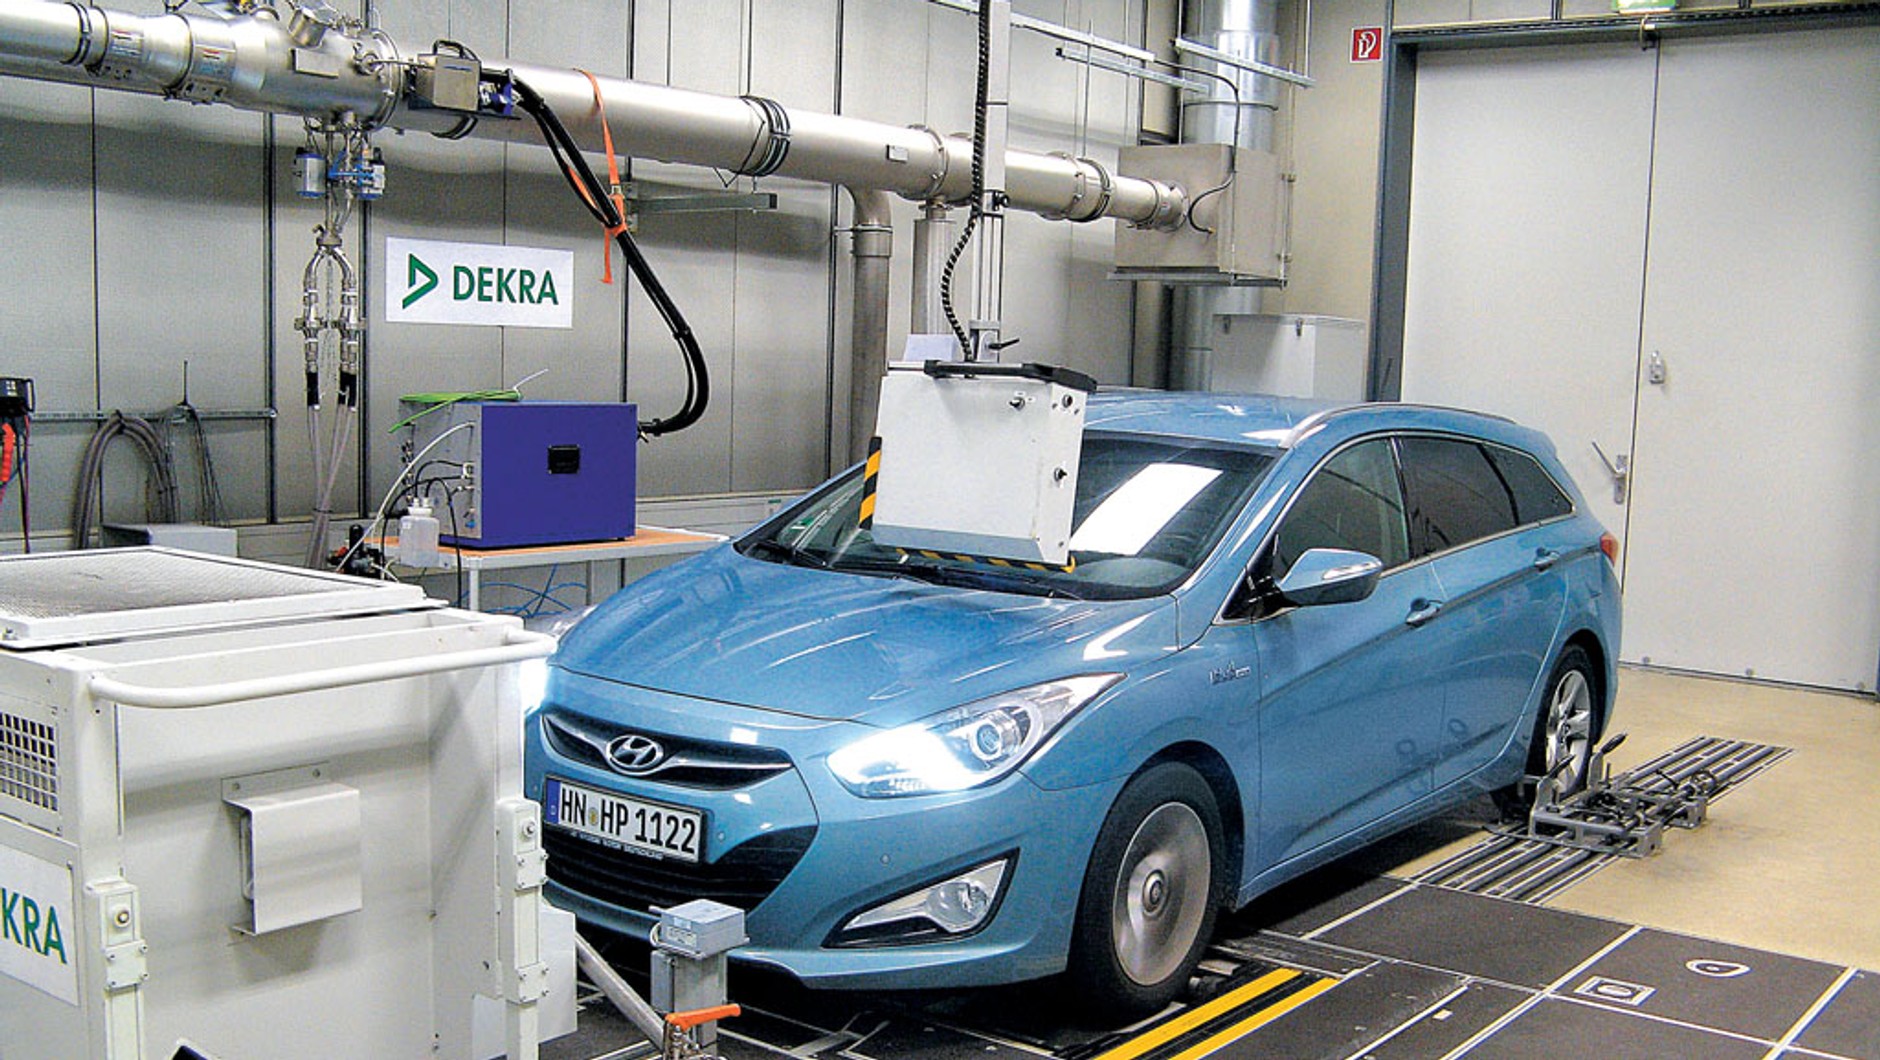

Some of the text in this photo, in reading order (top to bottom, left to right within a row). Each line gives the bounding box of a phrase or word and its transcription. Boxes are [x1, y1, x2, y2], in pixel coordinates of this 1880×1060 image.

[453, 265, 559, 305] DEKRA
[562, 788, 586, 826] HN
[601, 799, 628, 836] HP
[635, 809, 695, 854] 1122
[1, 887, 67, 964] KRA
